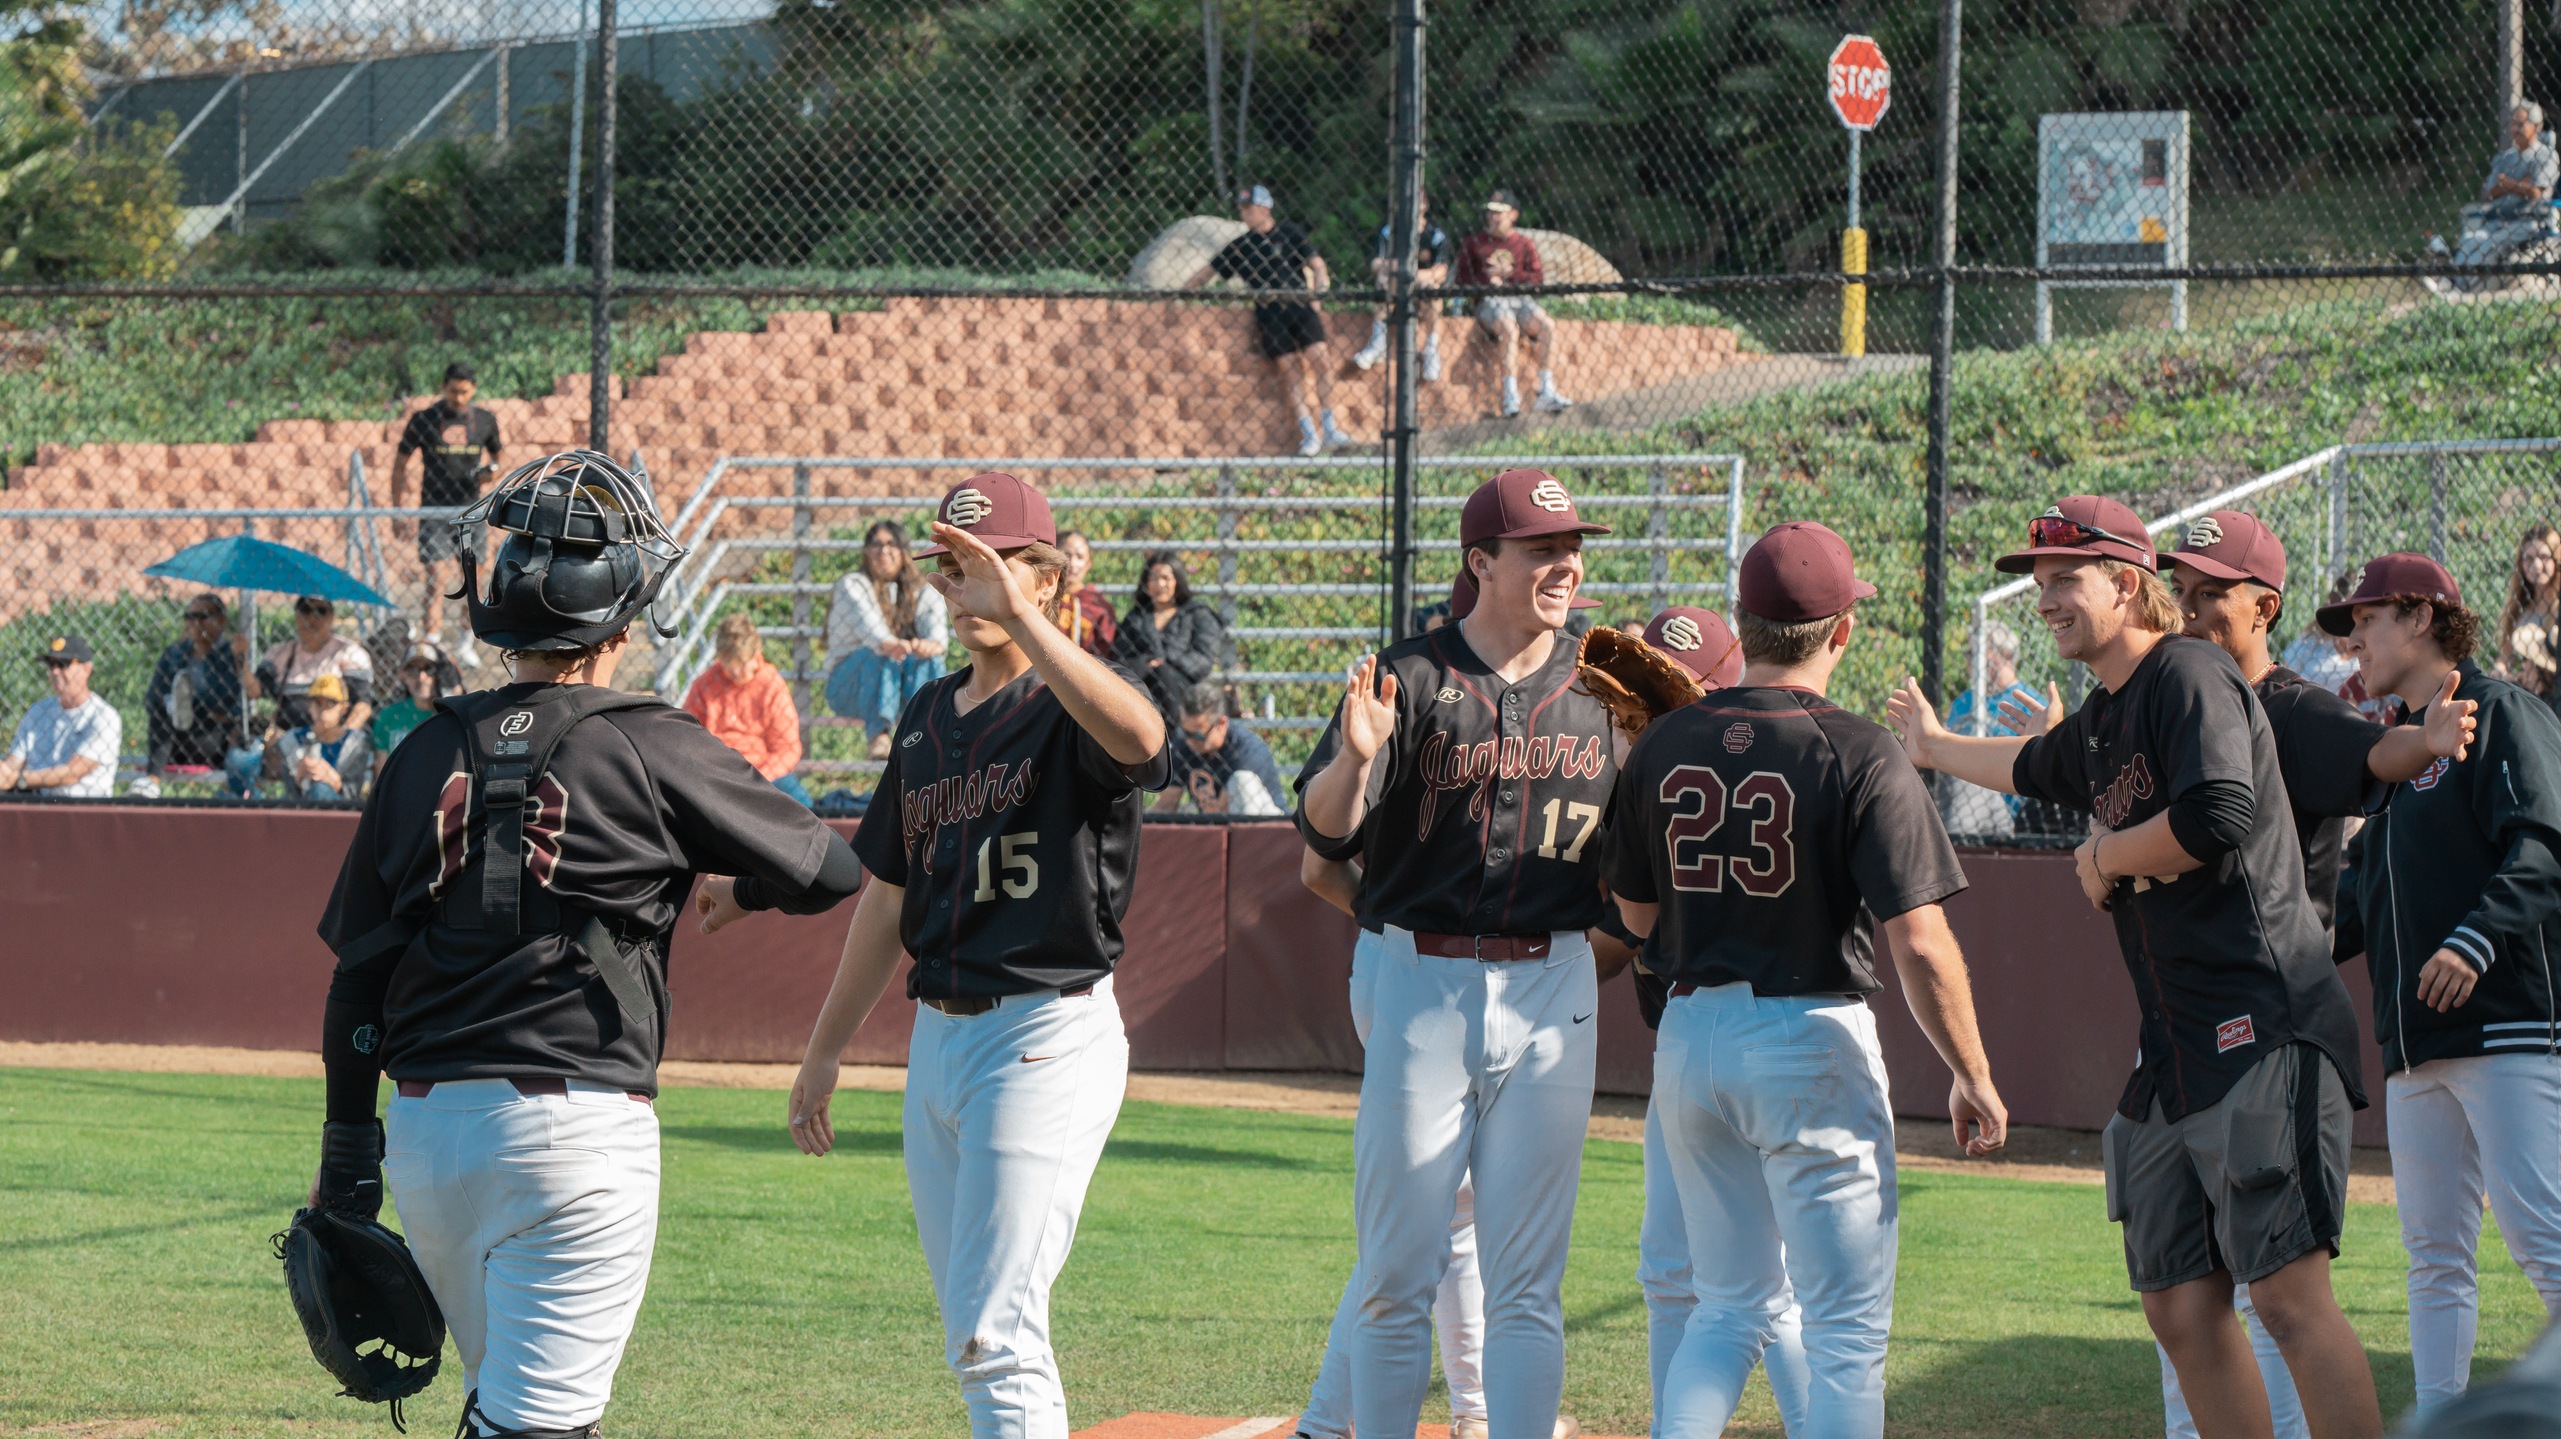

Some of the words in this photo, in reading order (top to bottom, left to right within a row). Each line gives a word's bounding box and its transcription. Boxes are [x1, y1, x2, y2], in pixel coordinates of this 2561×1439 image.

[1832, 64, 1888, 101] STOP
[1419, 731, 1606, 842] Jaguars
[1538, 798, 1599, 863] 17
[1660, 764, 1795, 898] 23
[974, 831, 1038, 902] 15
